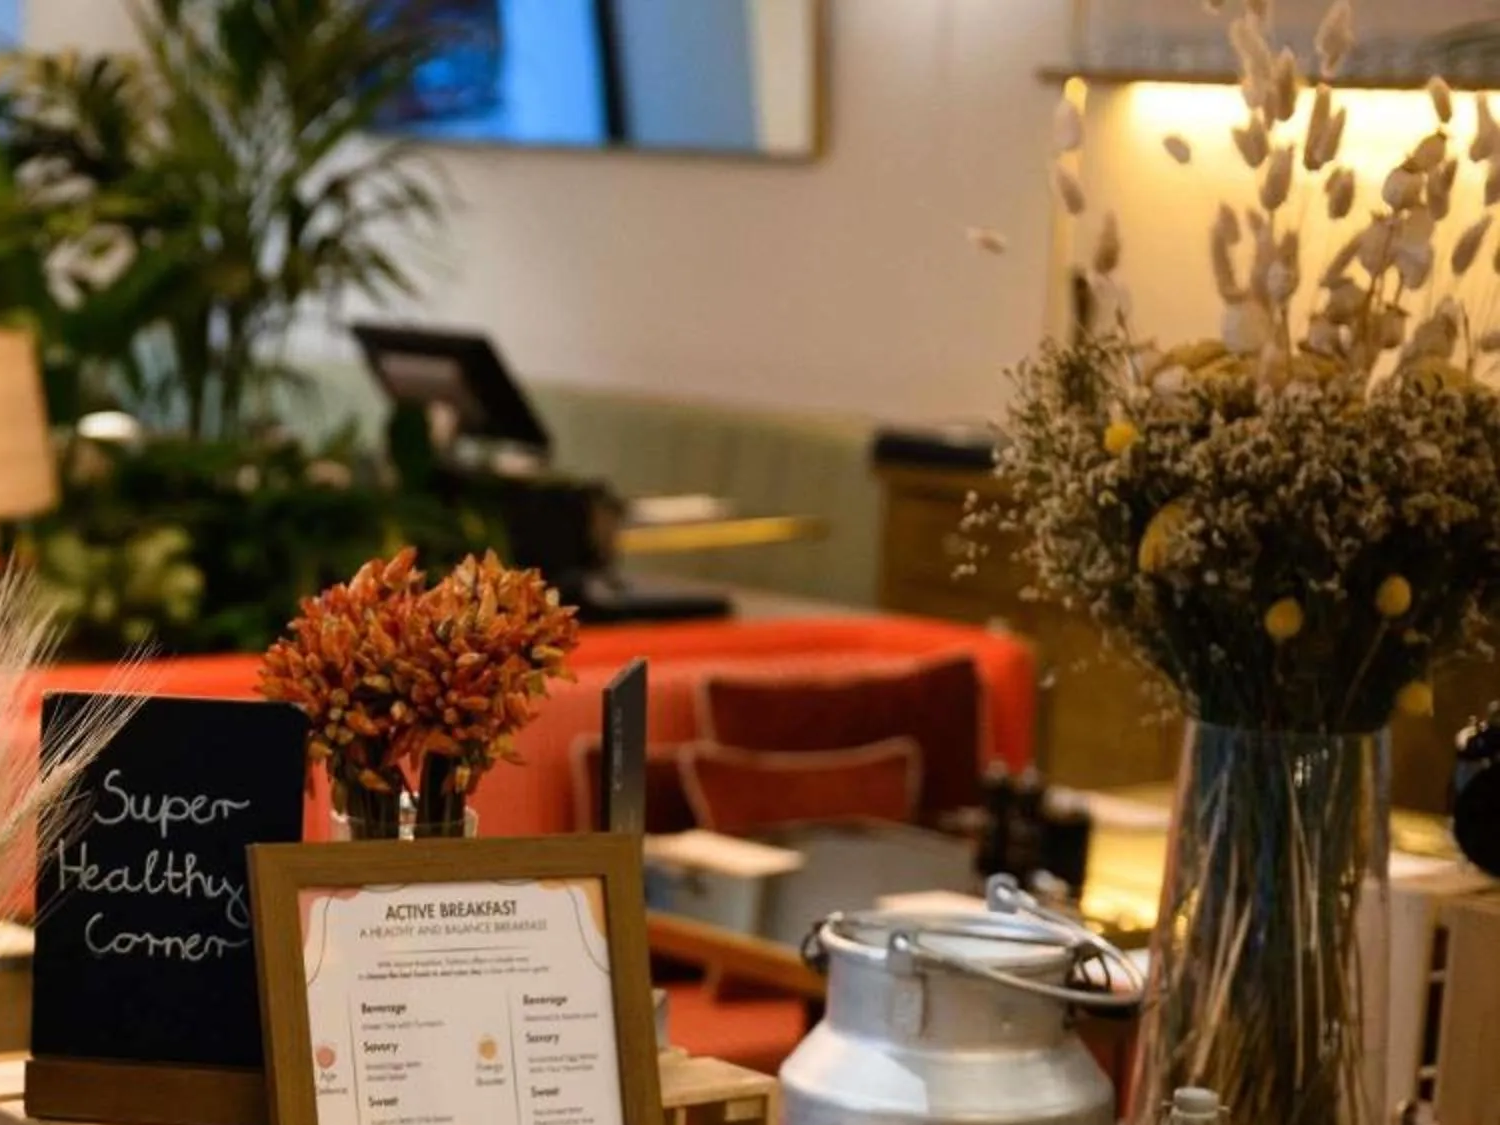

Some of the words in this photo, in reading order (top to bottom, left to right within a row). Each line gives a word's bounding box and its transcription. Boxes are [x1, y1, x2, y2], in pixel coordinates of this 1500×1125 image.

[93, 768, 250, 838] Super
[56, 838, 250, 928] Healthy
[385, 904, 435, 921] ACTIVE
[439, 900, 517, 918] BREAKFAST
[85, 912, 250, 961] Corner
[359, 929, 369, 939] A
[370, 925, 414, 938] HEALTHY
[418, 924, 442, 936] AND
[445, 922, 490, 935] BALANCE
[523, 995, 567, 1007] Beverage
[361, 1003, 407, 1015] Beverage
[525, 1032, 560, 1045] Savory
[363, 1041, 399, 1054] Savory
[531, 1086, 560, 1098] Sweet
[368, 1096, 399, 1107] Sweet
